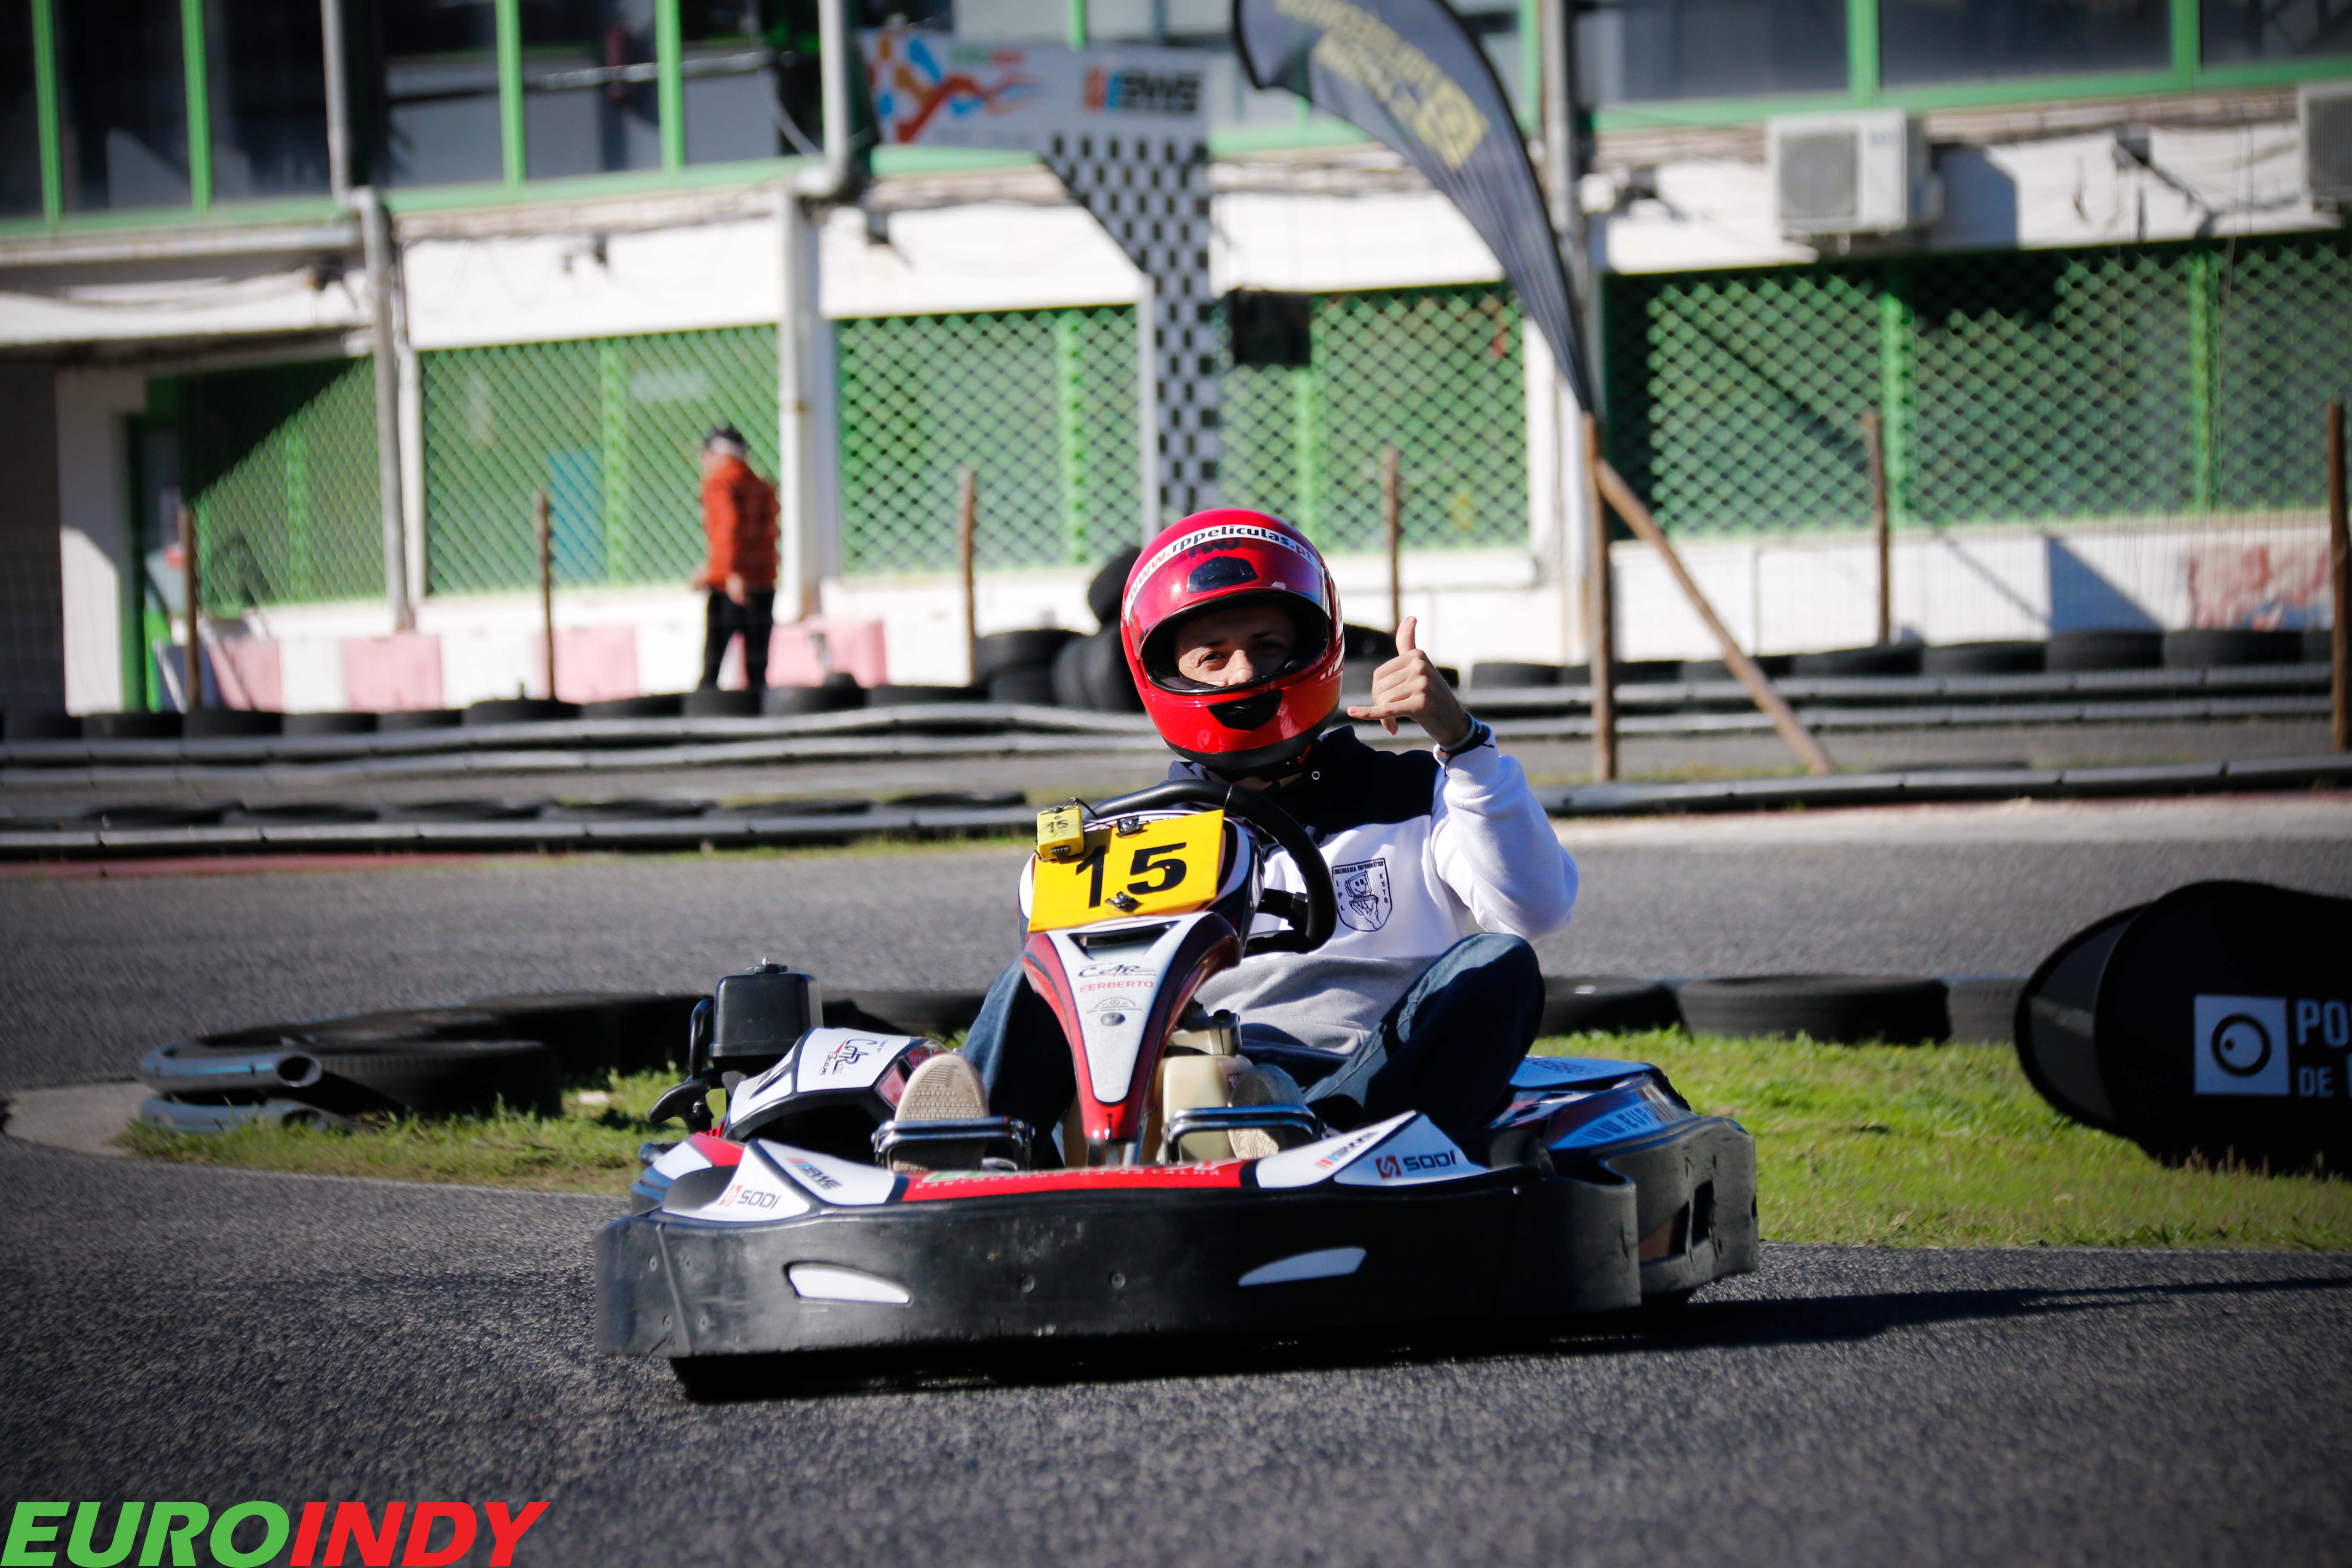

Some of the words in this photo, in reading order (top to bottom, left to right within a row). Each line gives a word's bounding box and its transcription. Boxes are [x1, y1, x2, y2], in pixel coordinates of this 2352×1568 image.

[1076, 842, 1187, 908] 15
[1079, 980, 1154, 993] FERBERTO
[2296, 999, 2352, 1048] PO
[2298, 1066, 2335, 1098] DE
[1403, 1149, 1457, 1171] SODI
[737, 1190, 782, 1210] SODI
